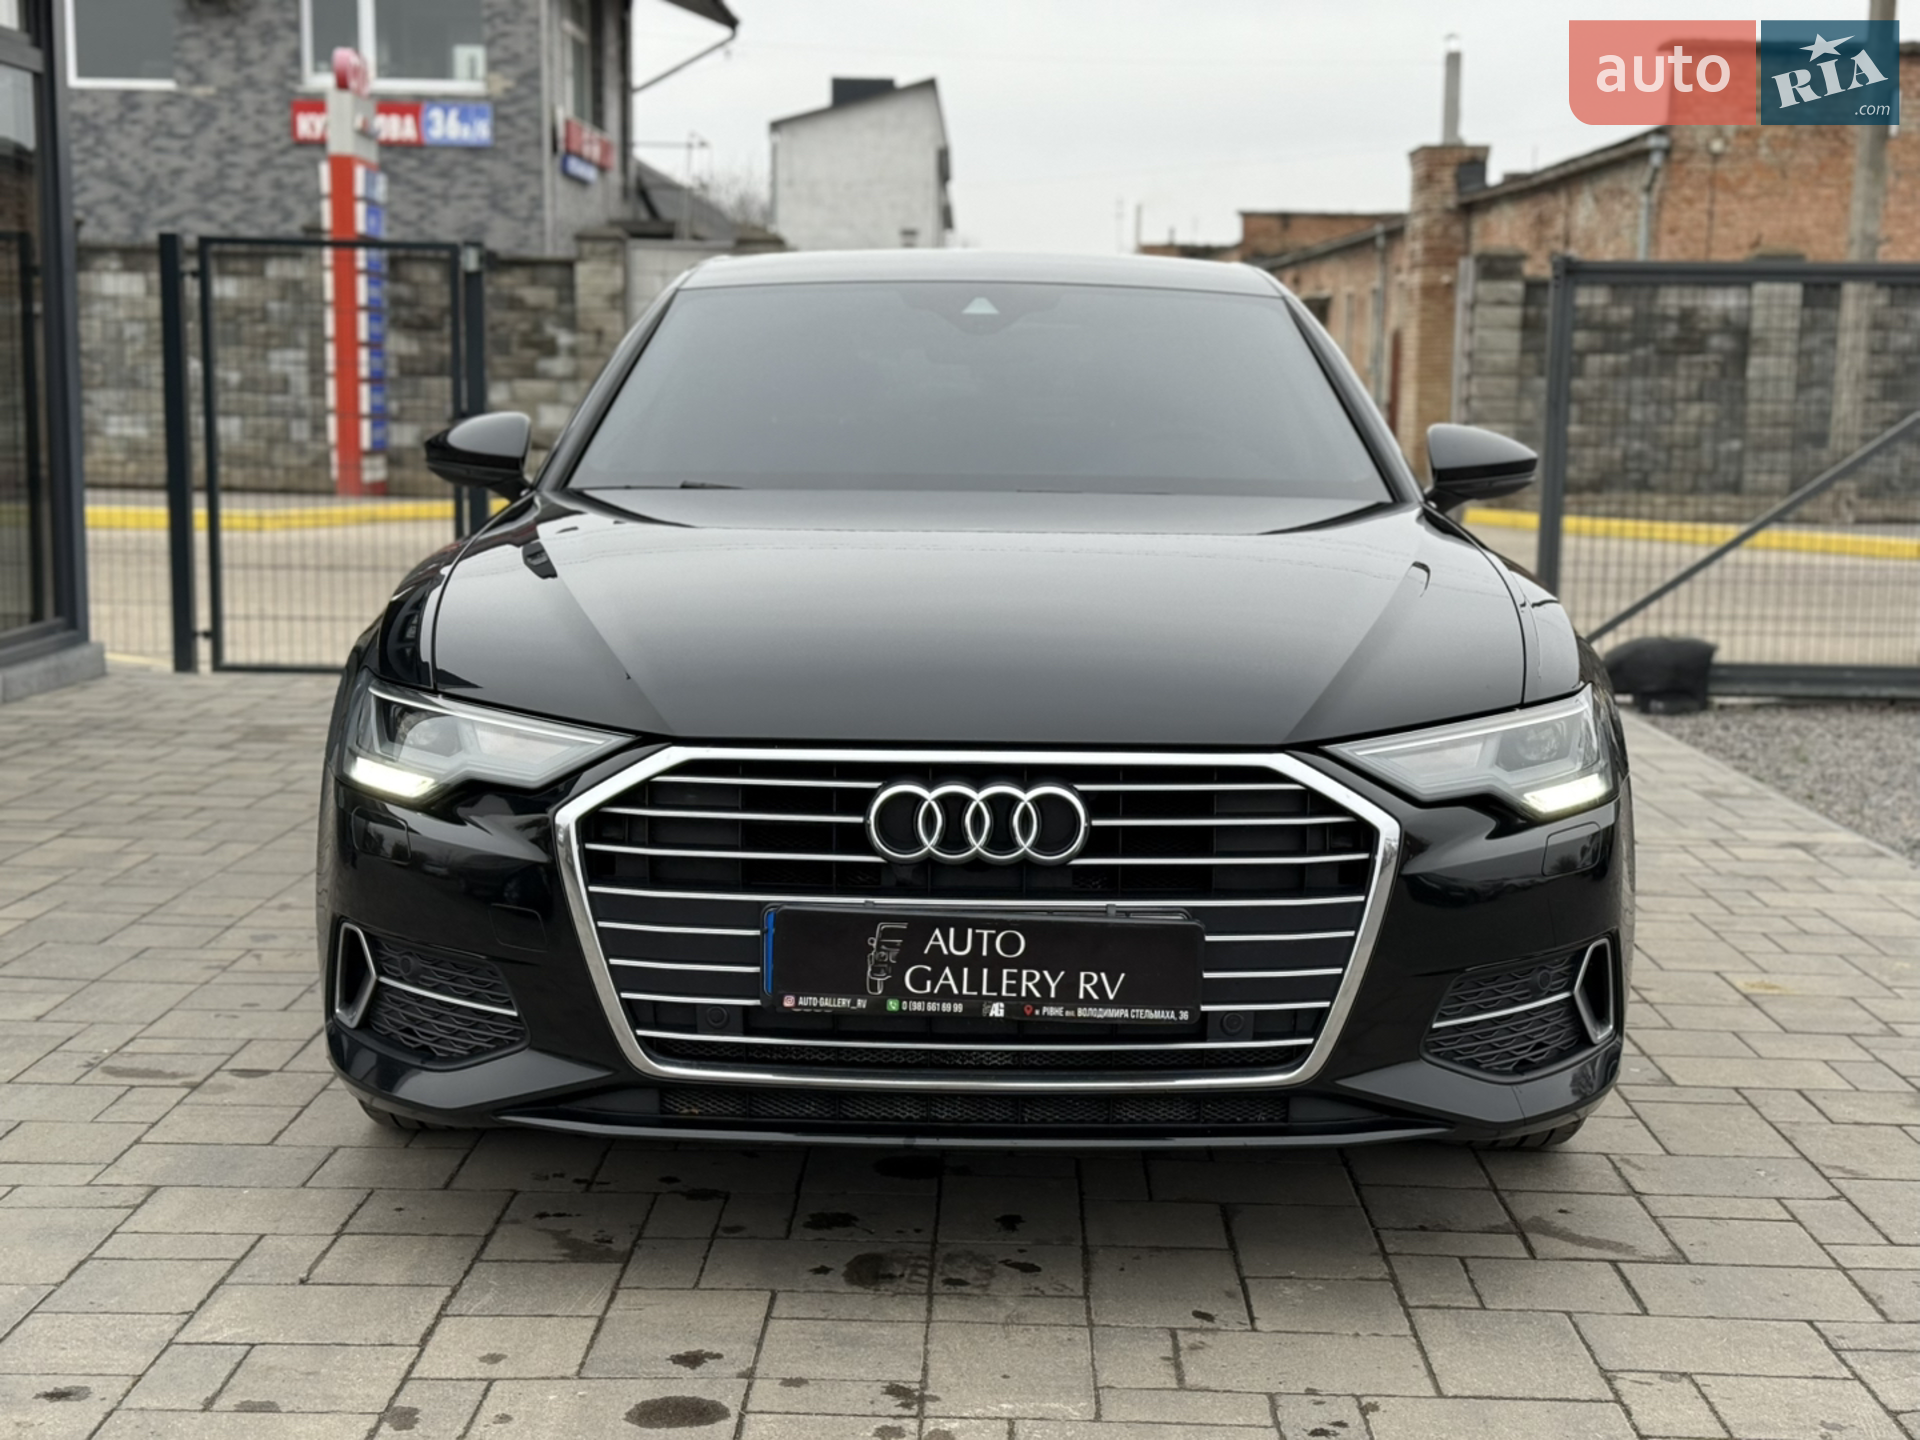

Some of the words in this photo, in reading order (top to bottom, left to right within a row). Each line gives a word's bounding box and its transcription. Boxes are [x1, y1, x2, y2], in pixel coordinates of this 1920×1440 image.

[923, 927, 1027, 958] AUTO
[903, 965, 1066, 999] GALLERY
[1077, 971, 1126, 1001] RV
[1041, 1006, 1064, 1017] РІВНЕ
[1077, 1007, 1129, 1019] ВОЛОДИМИРА
[1178, 1010, 1189, 1021] 36
